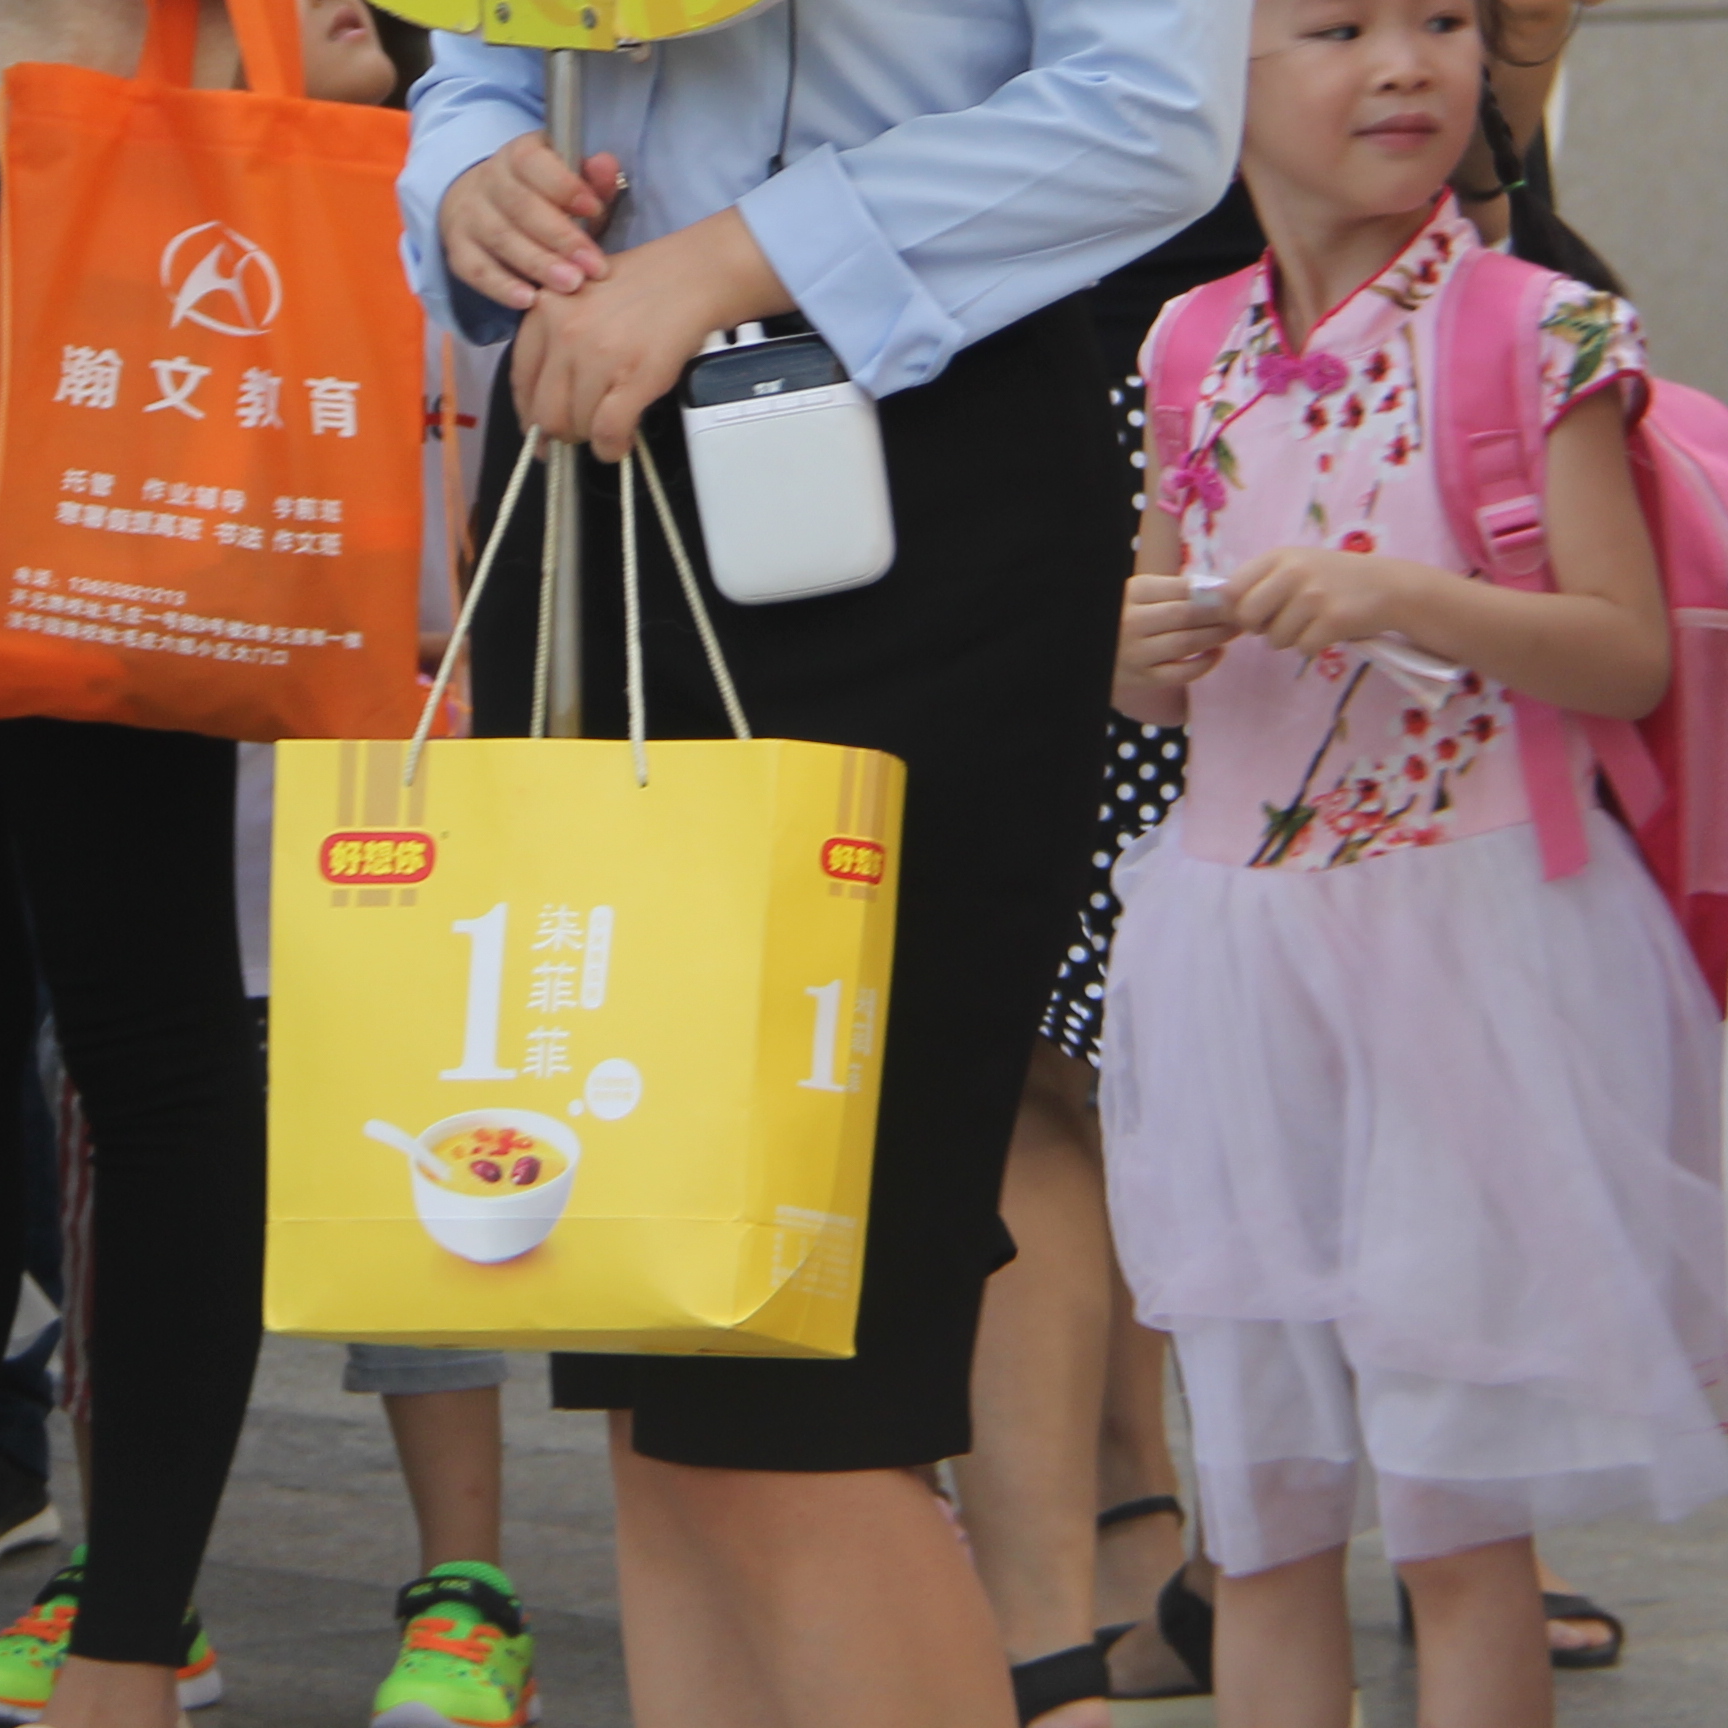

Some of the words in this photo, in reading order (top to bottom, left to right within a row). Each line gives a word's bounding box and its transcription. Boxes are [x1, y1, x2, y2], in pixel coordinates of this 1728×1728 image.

[53, 344, 361, 439] 瀚文教育
[271, 528, 343, 557] 作文班
[328, 839, 428, 877] 好想你
[438, 901, 517, 1082] 1
[795, 978, 847, 1094] 1
